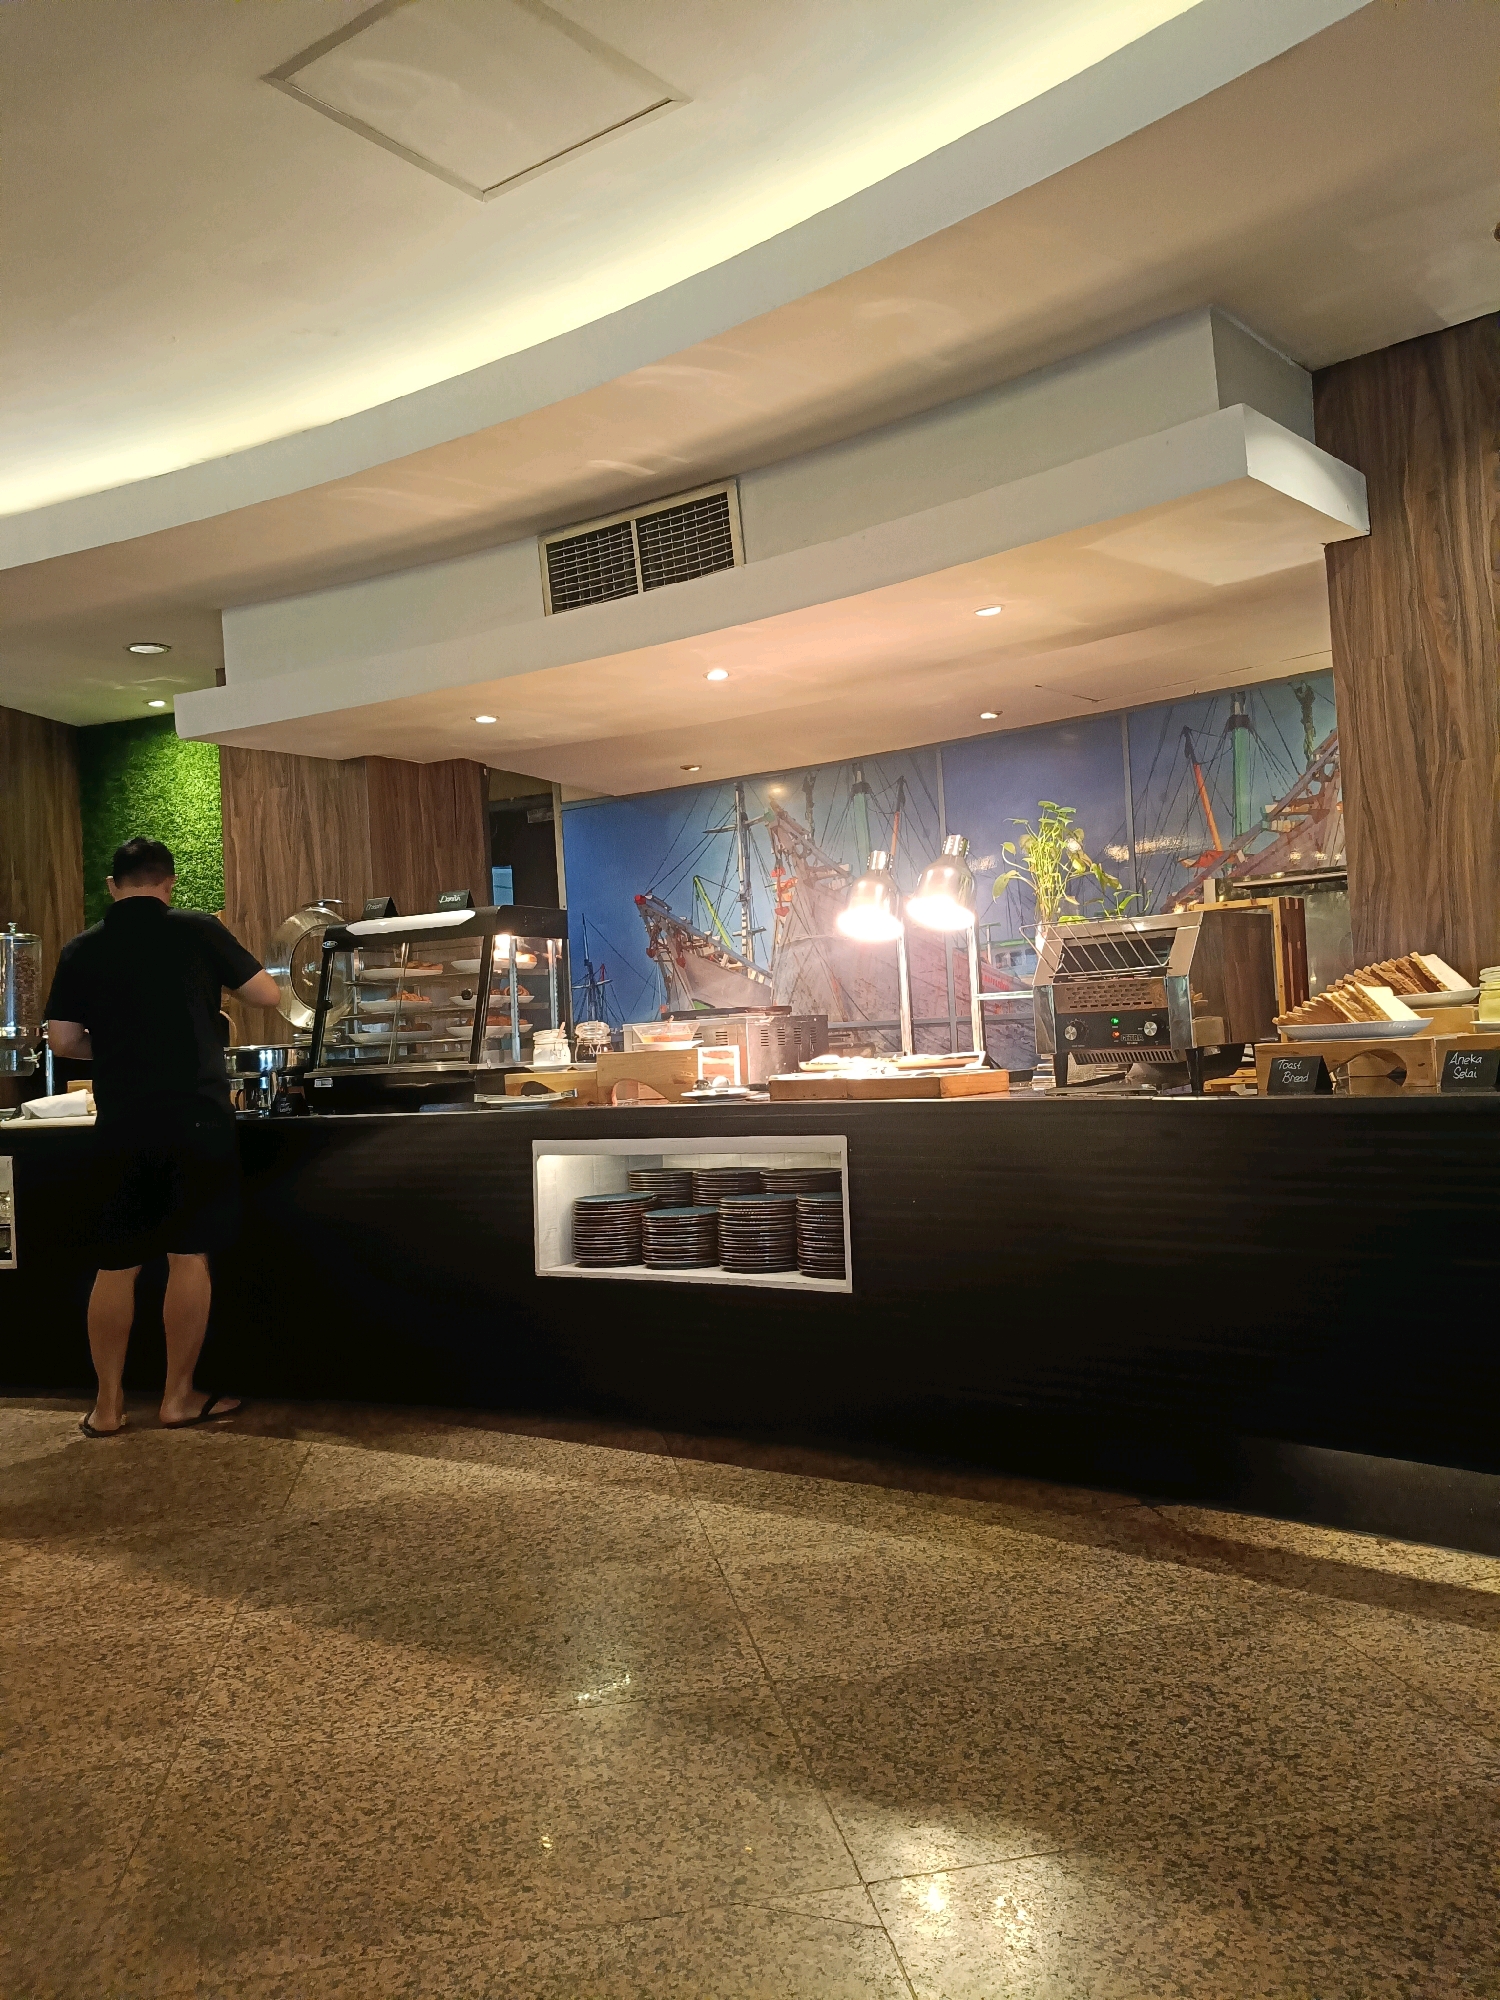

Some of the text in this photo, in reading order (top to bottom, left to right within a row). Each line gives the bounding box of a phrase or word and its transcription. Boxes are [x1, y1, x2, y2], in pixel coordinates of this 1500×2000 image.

[1277, 1059, 1302, 1070] Toast
[1449, 1051, 1483, 1065] Aneka
[1282, 1071, 1310, 1084] Bread
[1453, 1066, 1477, 1079] Selai
